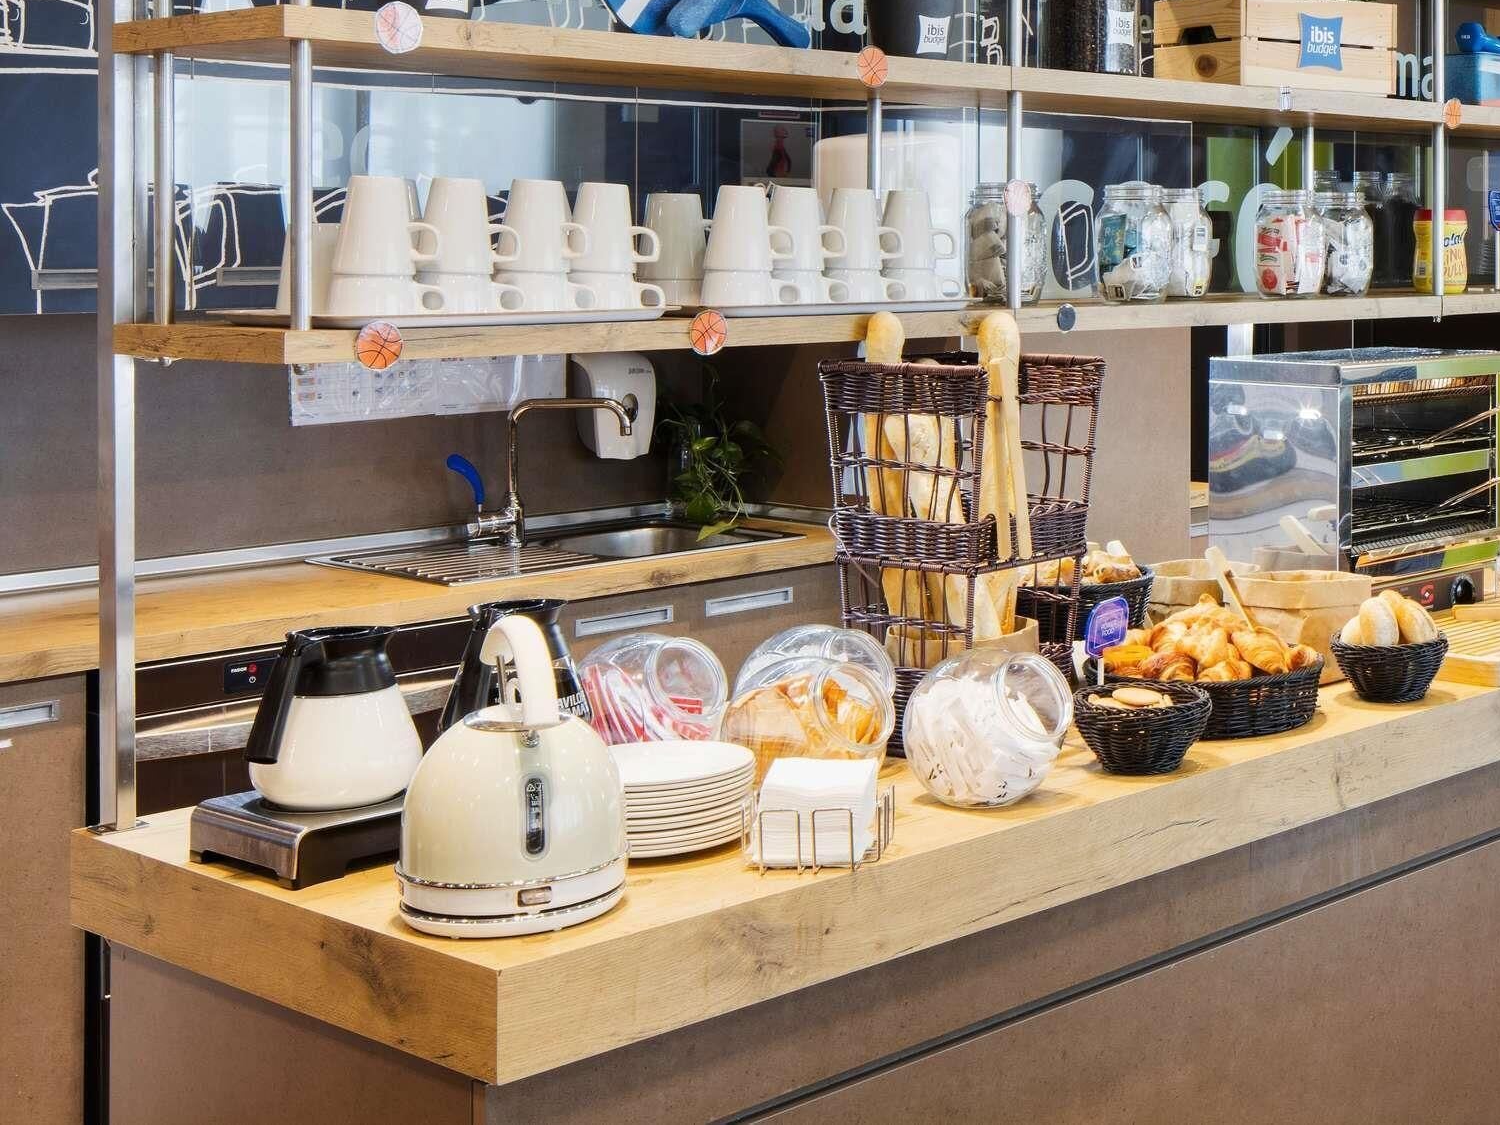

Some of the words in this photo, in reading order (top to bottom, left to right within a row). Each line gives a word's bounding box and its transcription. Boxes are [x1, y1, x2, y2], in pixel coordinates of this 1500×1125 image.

[927, 23, 945, 36] ibis
[1115, 16, 1132, 29] ibis
[1310, 25, 1335, 44] ibis
[1306, 41, 1338, 57] budget
